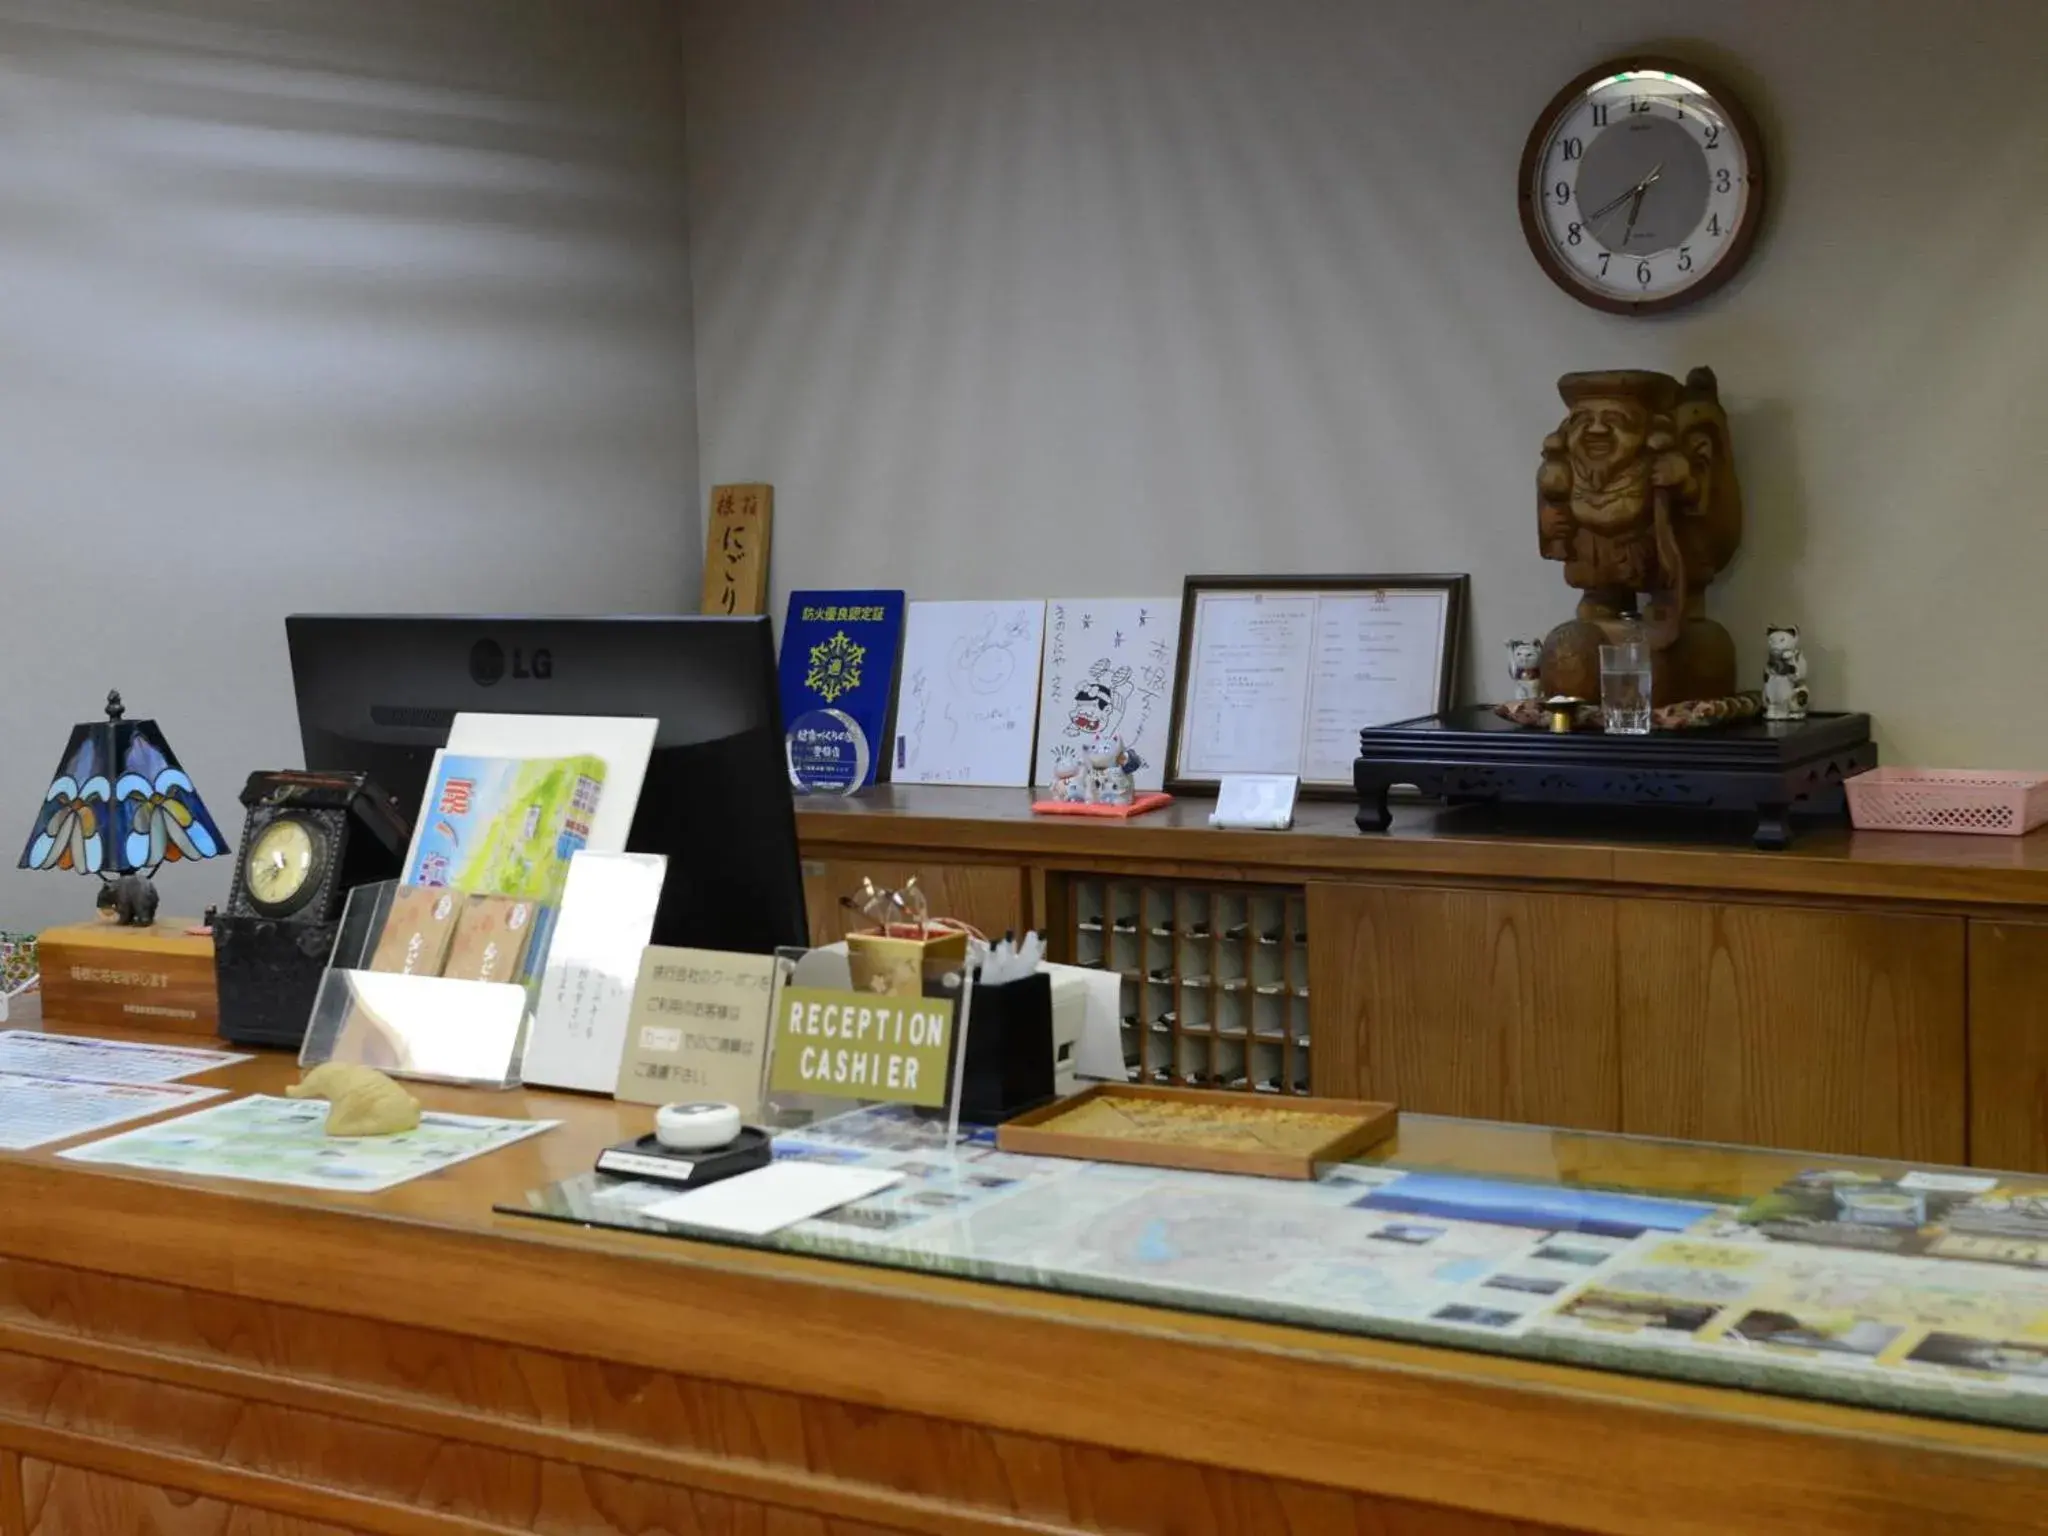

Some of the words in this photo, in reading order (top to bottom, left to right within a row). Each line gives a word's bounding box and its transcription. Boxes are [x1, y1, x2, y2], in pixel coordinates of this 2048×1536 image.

[1592, 103, 1607, 127] 11
[1629, 94, 1650, 113] 12
[1676, 98, 1685, 119] 1
[1704, 126, 1720, 149] 2
[1562, 139, 1583, 161] 10
[1716, 169, 1731, 193] 3
[1555, 182, 1570, 205] 9
[1568, 222, 1582, 246] 8
[1706, 213, 1720, 236] 4
[1598, 252, 1611, 276] 7
[1637, 259, 1651, 285] 6
[1677, 248, 1692, 272] 5
[801, 605, 885, 622] 防火優良認定証
[512, 649, 553, 679] LG
[789, 1001, 944, 1047] RECEPTION
[800, 1045, 920, 1091] CASHIER
